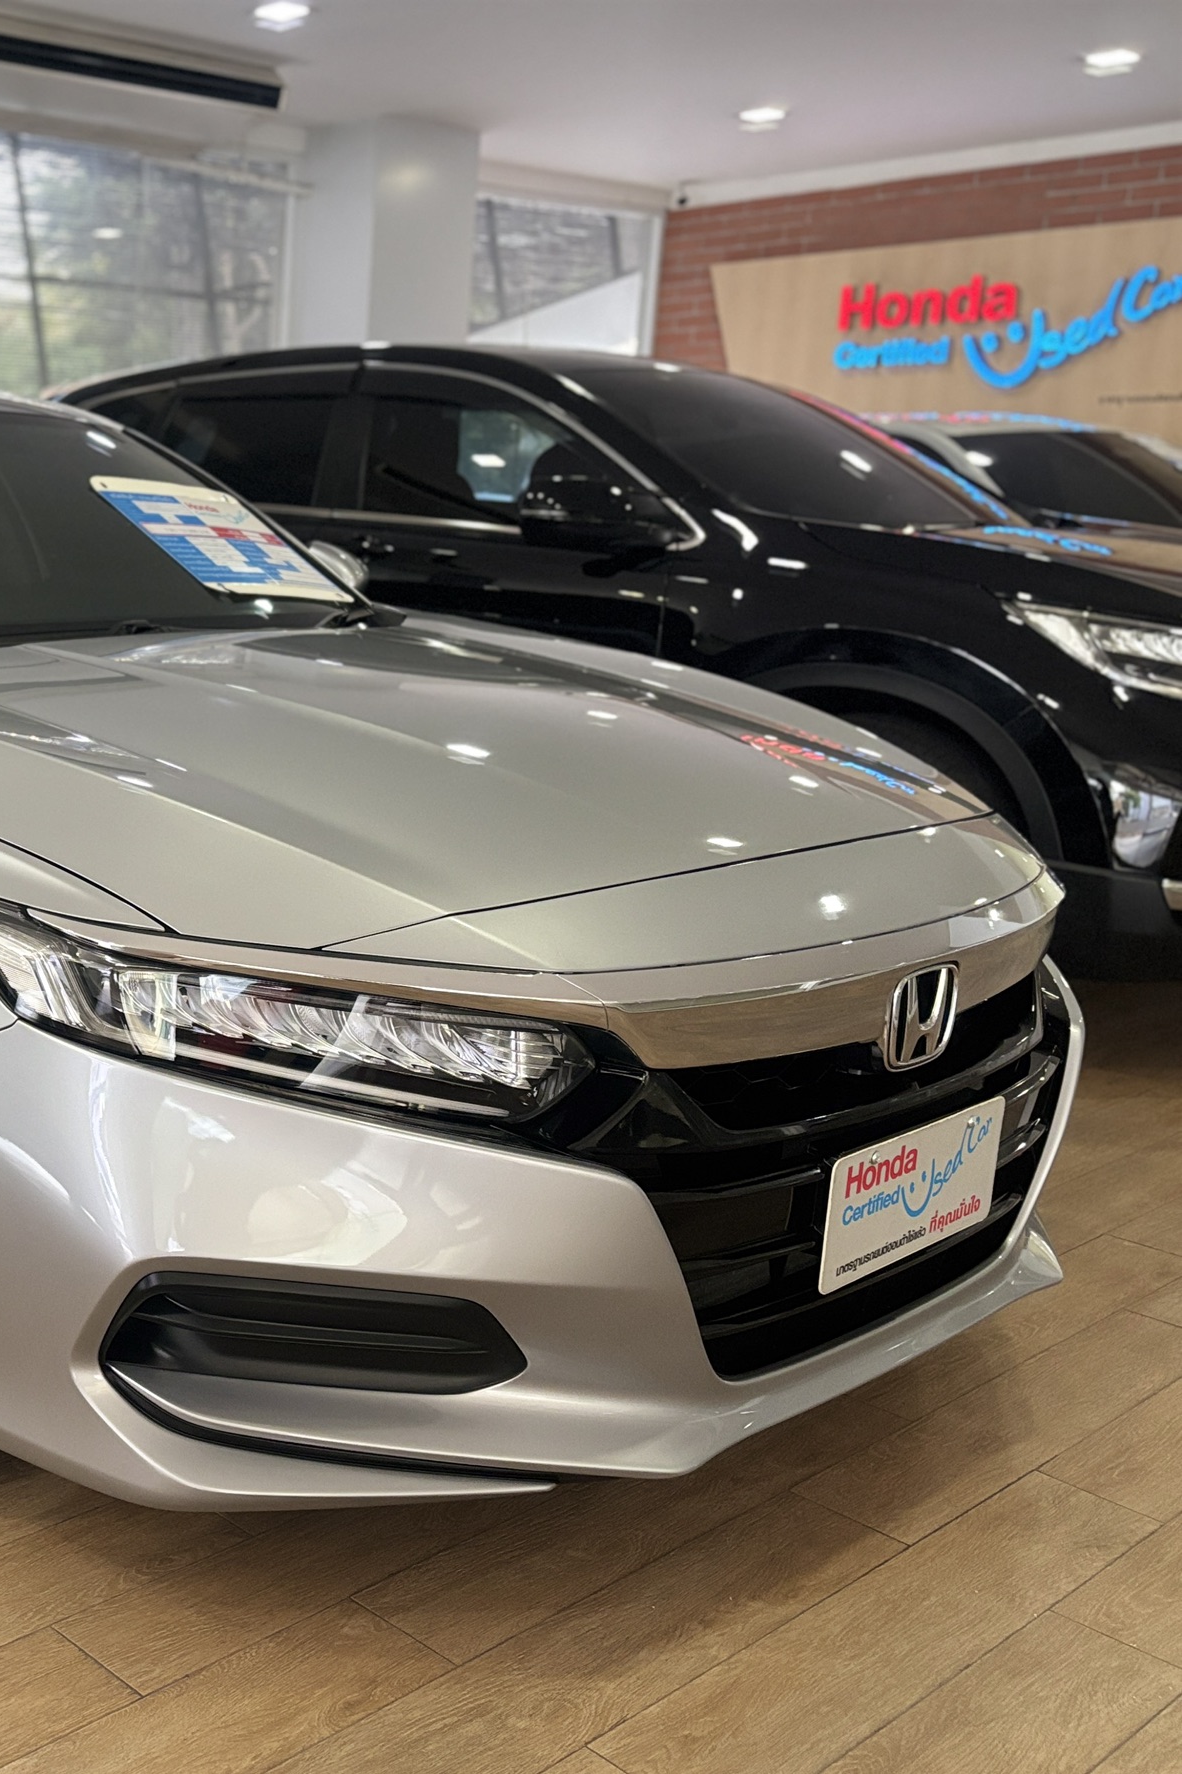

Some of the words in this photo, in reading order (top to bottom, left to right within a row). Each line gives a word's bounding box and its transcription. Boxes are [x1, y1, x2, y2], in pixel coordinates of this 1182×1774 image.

[838, 274, 1018, 332] Honda
[833, 335, 952, 371] Certified
[842, 1184, 900, 1226] Certified
[901, 1122, 968, 1218] Used
[845, 1144, 918, 1199] Honda
[929, 1195, 981, 1233] ที่คุณมั่นใจ
